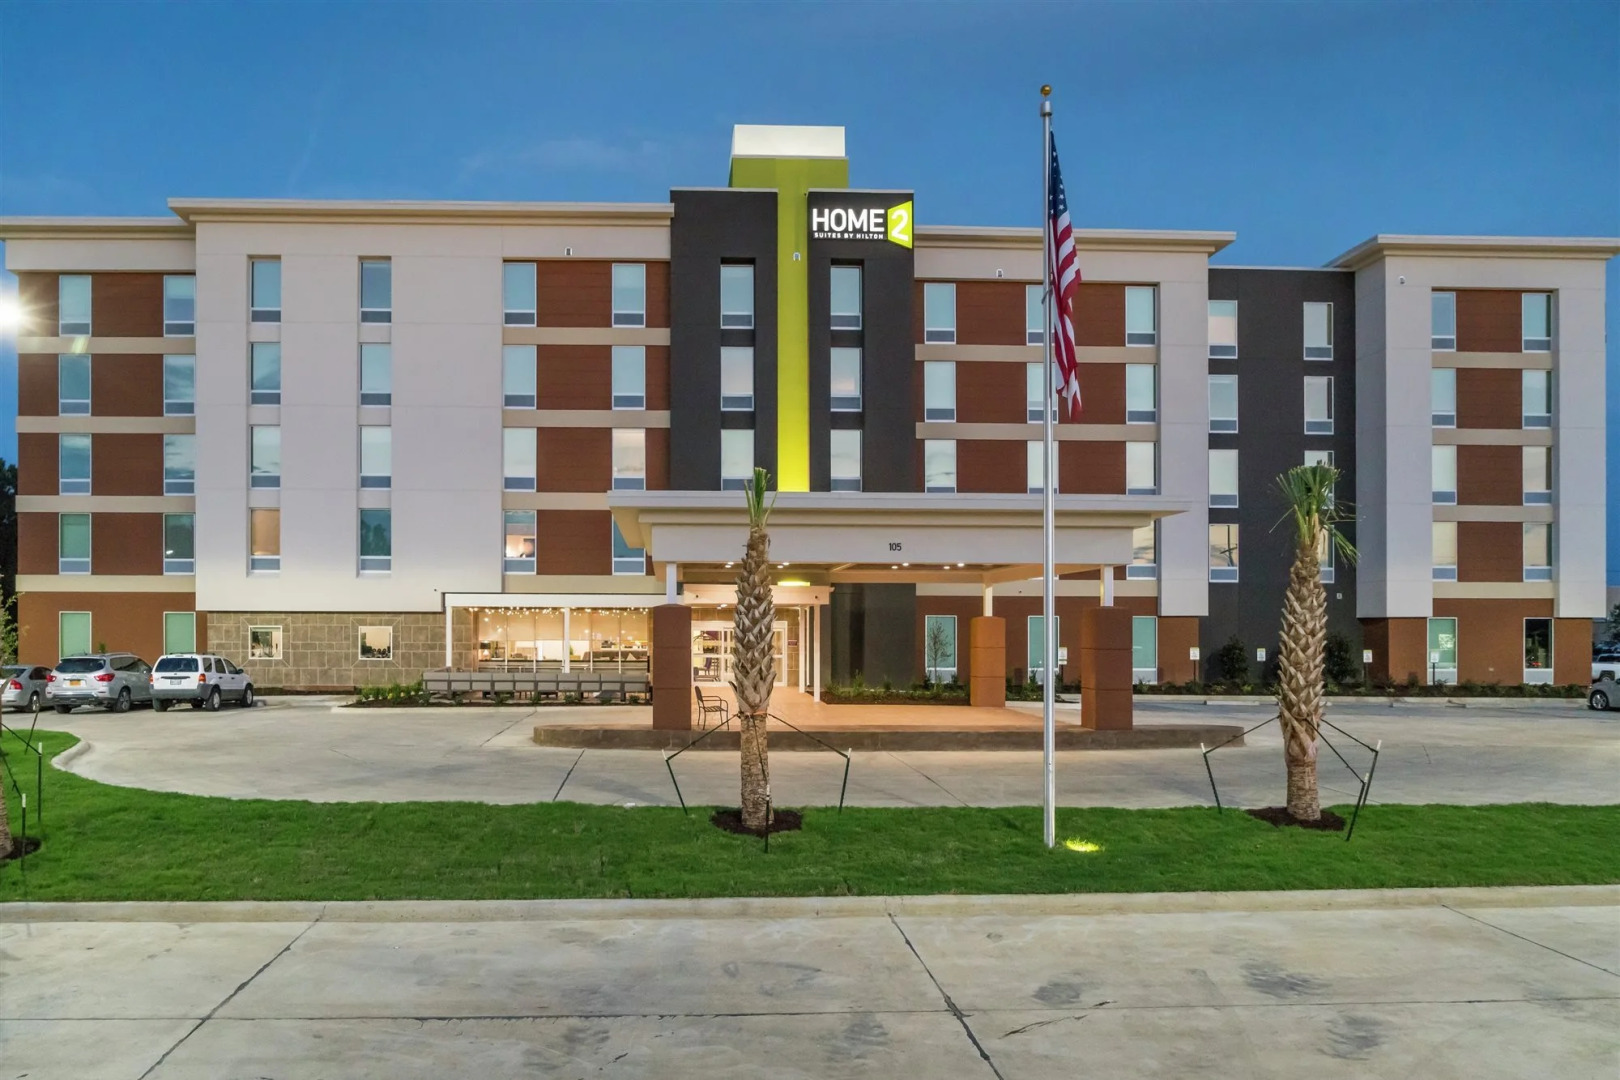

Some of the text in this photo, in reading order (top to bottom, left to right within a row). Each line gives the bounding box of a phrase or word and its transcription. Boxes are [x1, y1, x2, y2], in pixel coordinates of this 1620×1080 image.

[812, 208, 909, 242] HOME 2
[888, 542, 902, 551] 105
